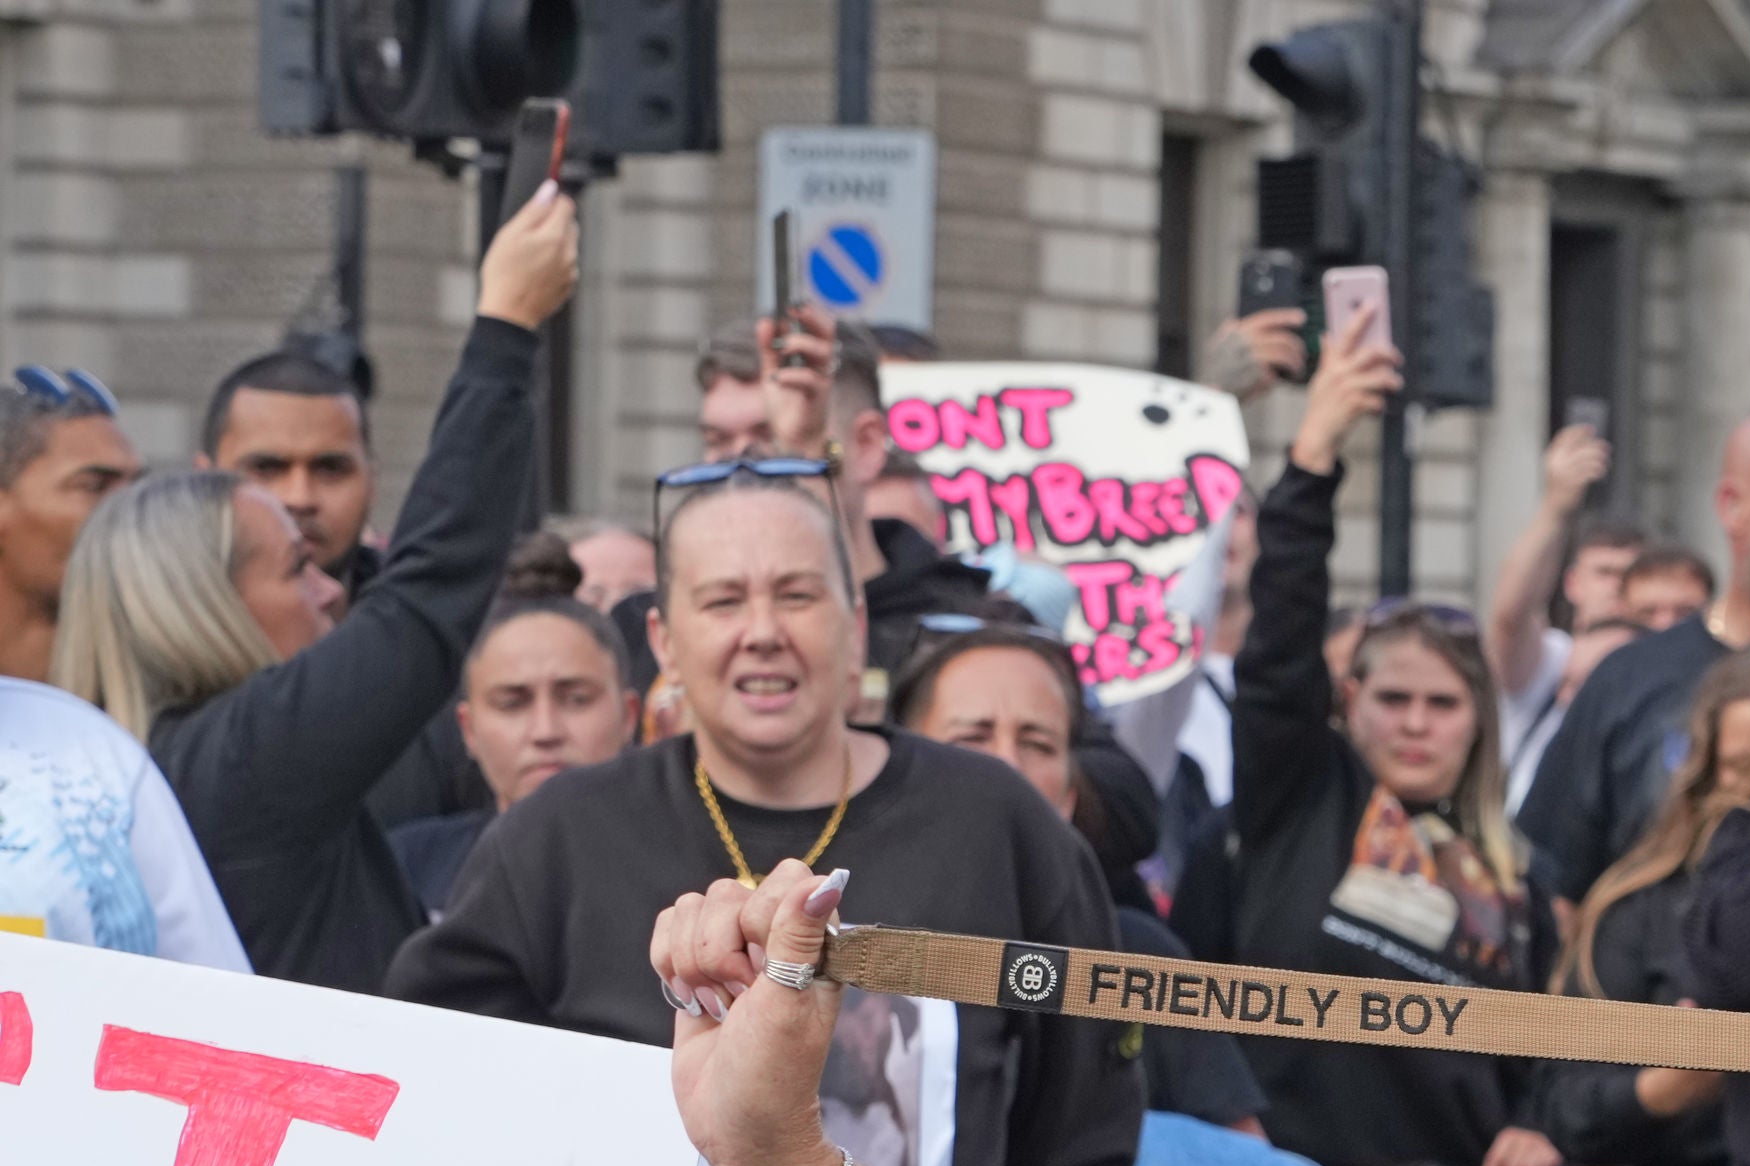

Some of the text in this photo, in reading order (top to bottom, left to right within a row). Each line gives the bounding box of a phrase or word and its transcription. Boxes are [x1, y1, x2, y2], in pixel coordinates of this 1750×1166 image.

[886, 387, 1075, 455] ONT
[1031, 454, 1243, 547] BREED
[1064, 560, 1184, 632] TH
[1088, 963, 1468, 1036] FRIENDLY BOY
